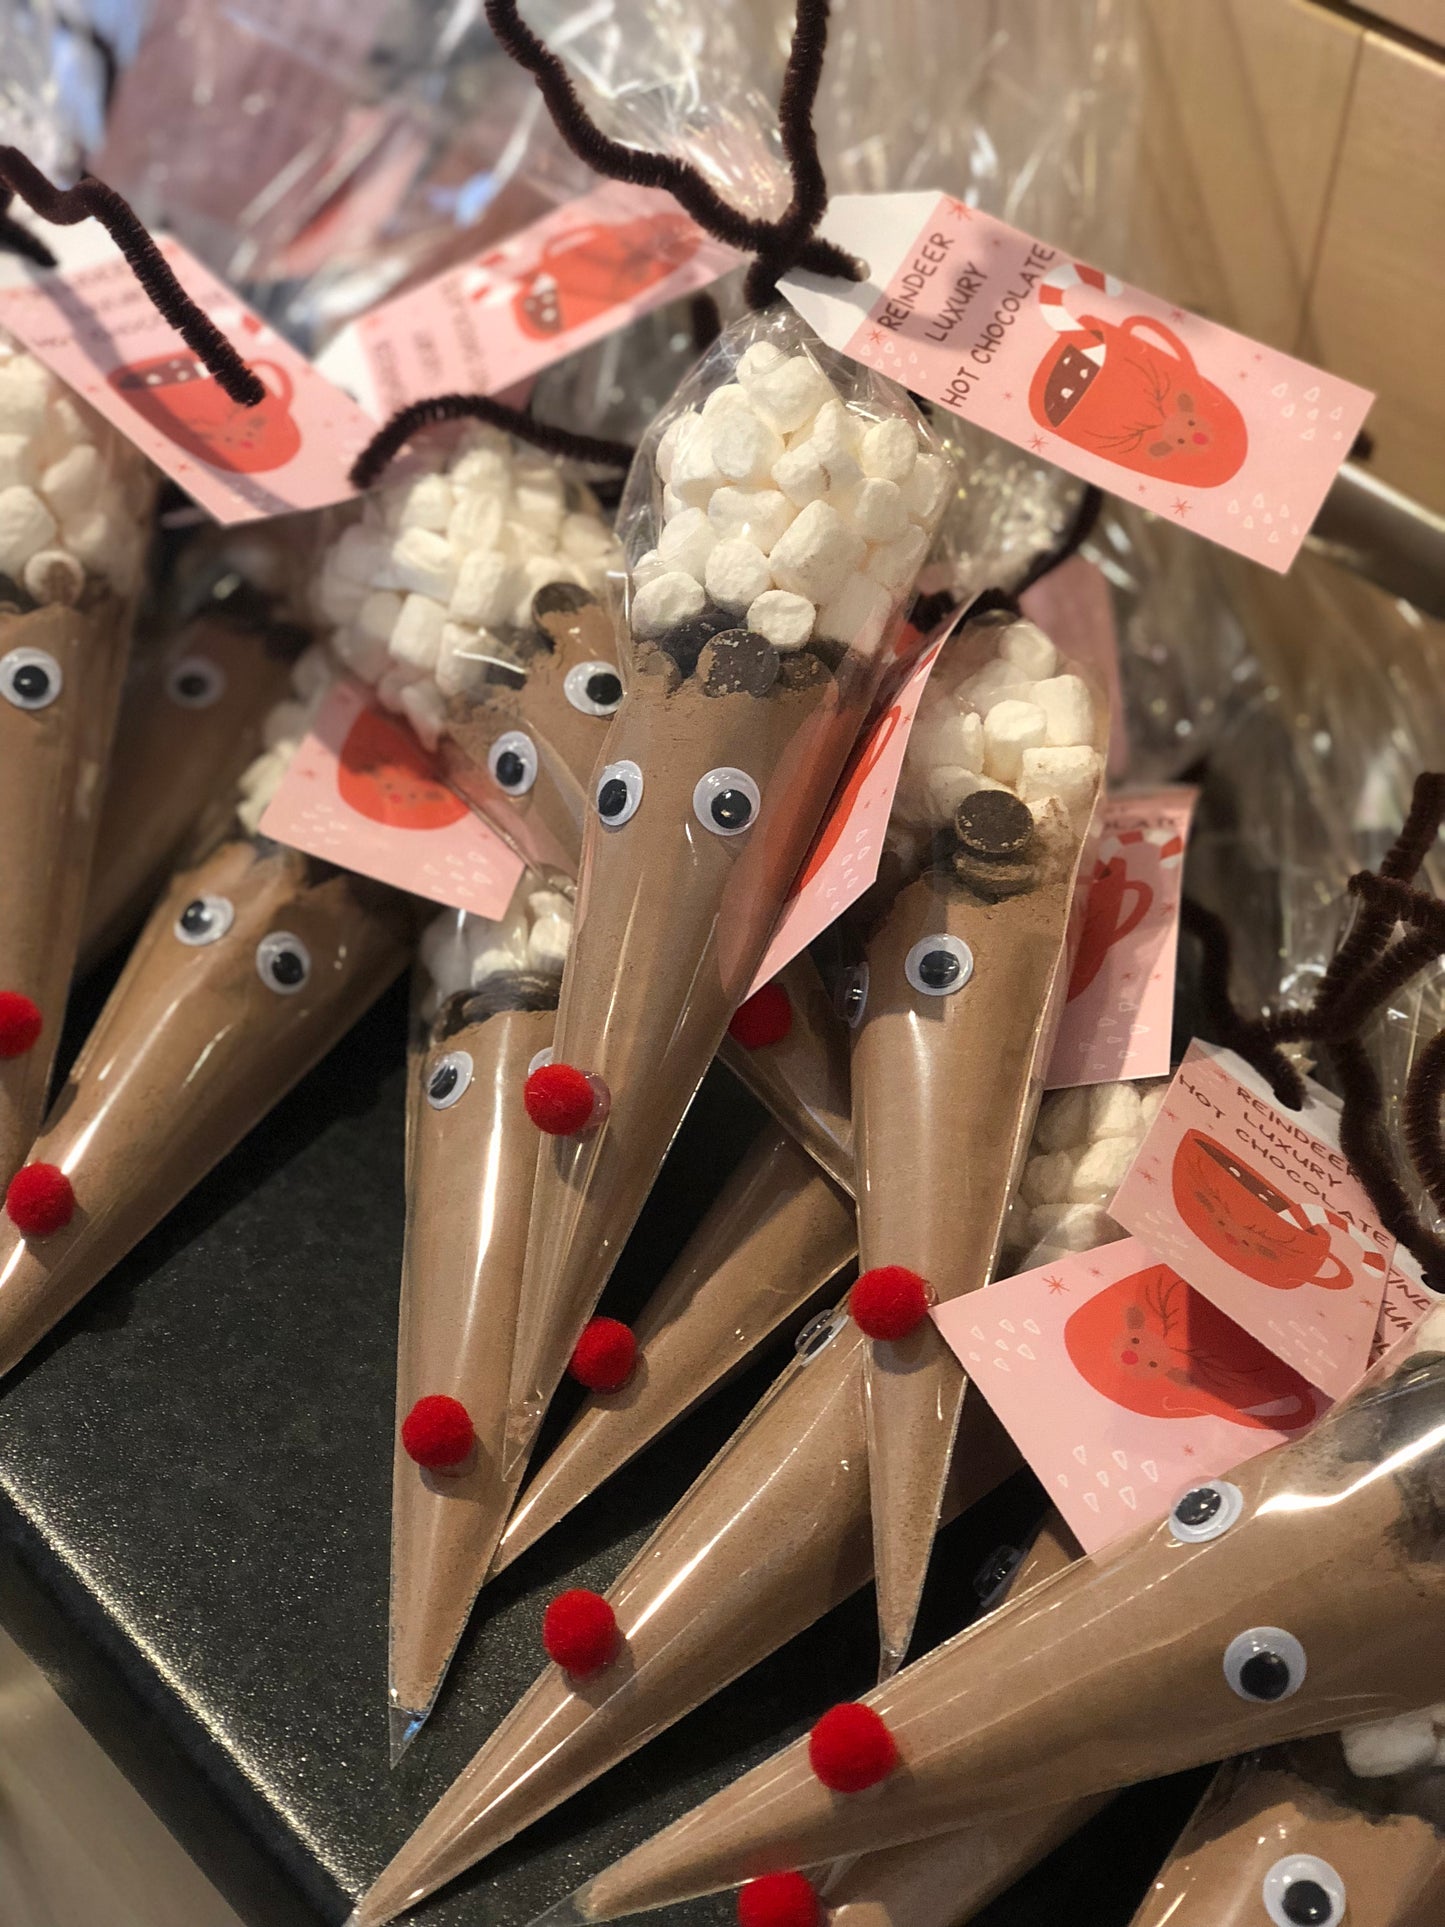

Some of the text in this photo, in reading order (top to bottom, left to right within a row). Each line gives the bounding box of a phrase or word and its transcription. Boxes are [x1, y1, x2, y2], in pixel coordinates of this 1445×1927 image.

[876, 232, 955, 332] REINDEER
[924, 261, 989, 342] LUXURY
[940, 243, 1056, 408] HOT CHOCOLATE
[1179, 1073, 1391, 1249] HOT CHOCOLATE
[1243, 1111, 1343, 1188] LUXURY
